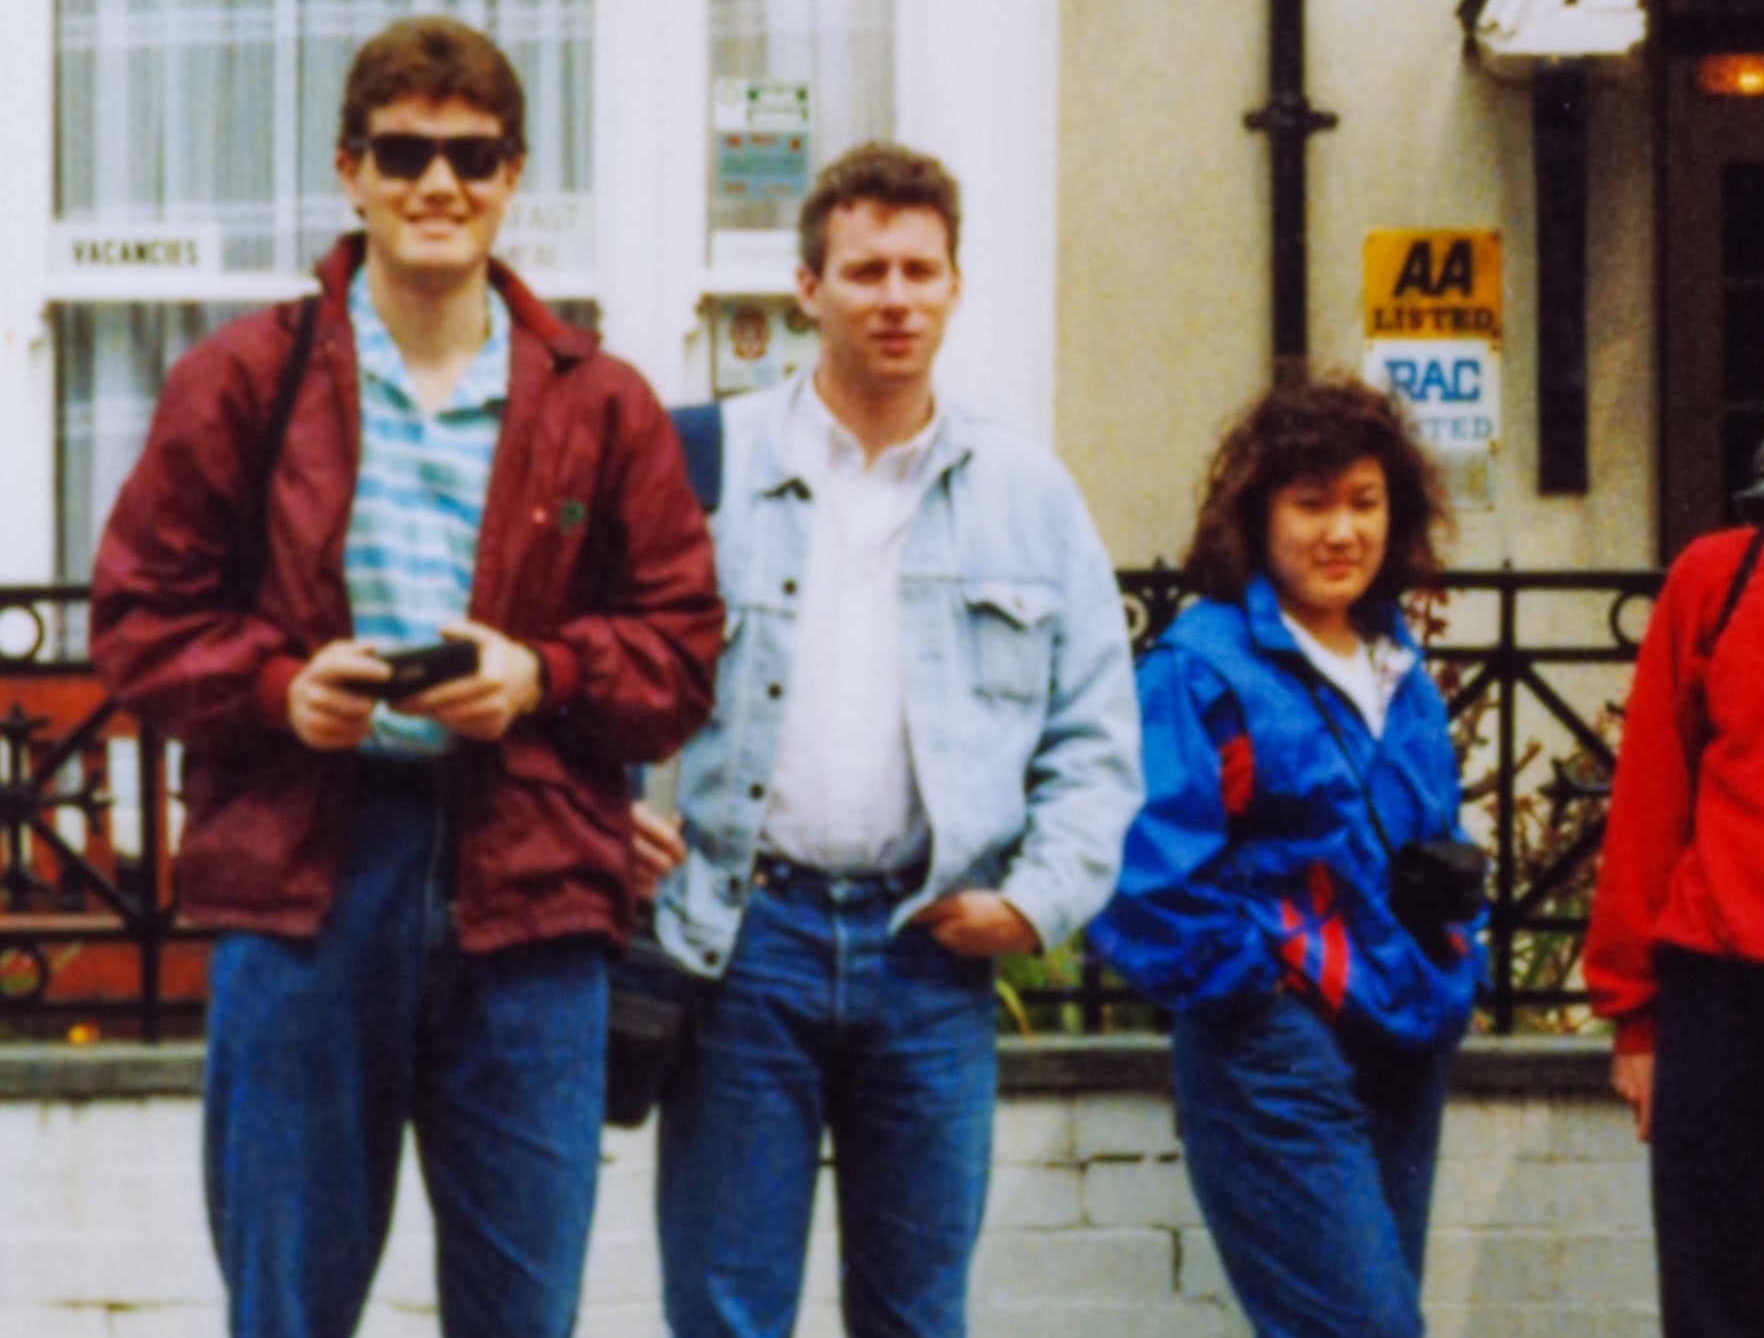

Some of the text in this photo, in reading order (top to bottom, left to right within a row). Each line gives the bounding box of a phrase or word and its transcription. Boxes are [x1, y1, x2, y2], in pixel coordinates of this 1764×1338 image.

[72, 238, 199, 266] VACANCIES
[1393, 238, 1473, 297] AA
[1374, 307, 1494, 331] LISTED
[1385, 359, 1481, 402] RAC
